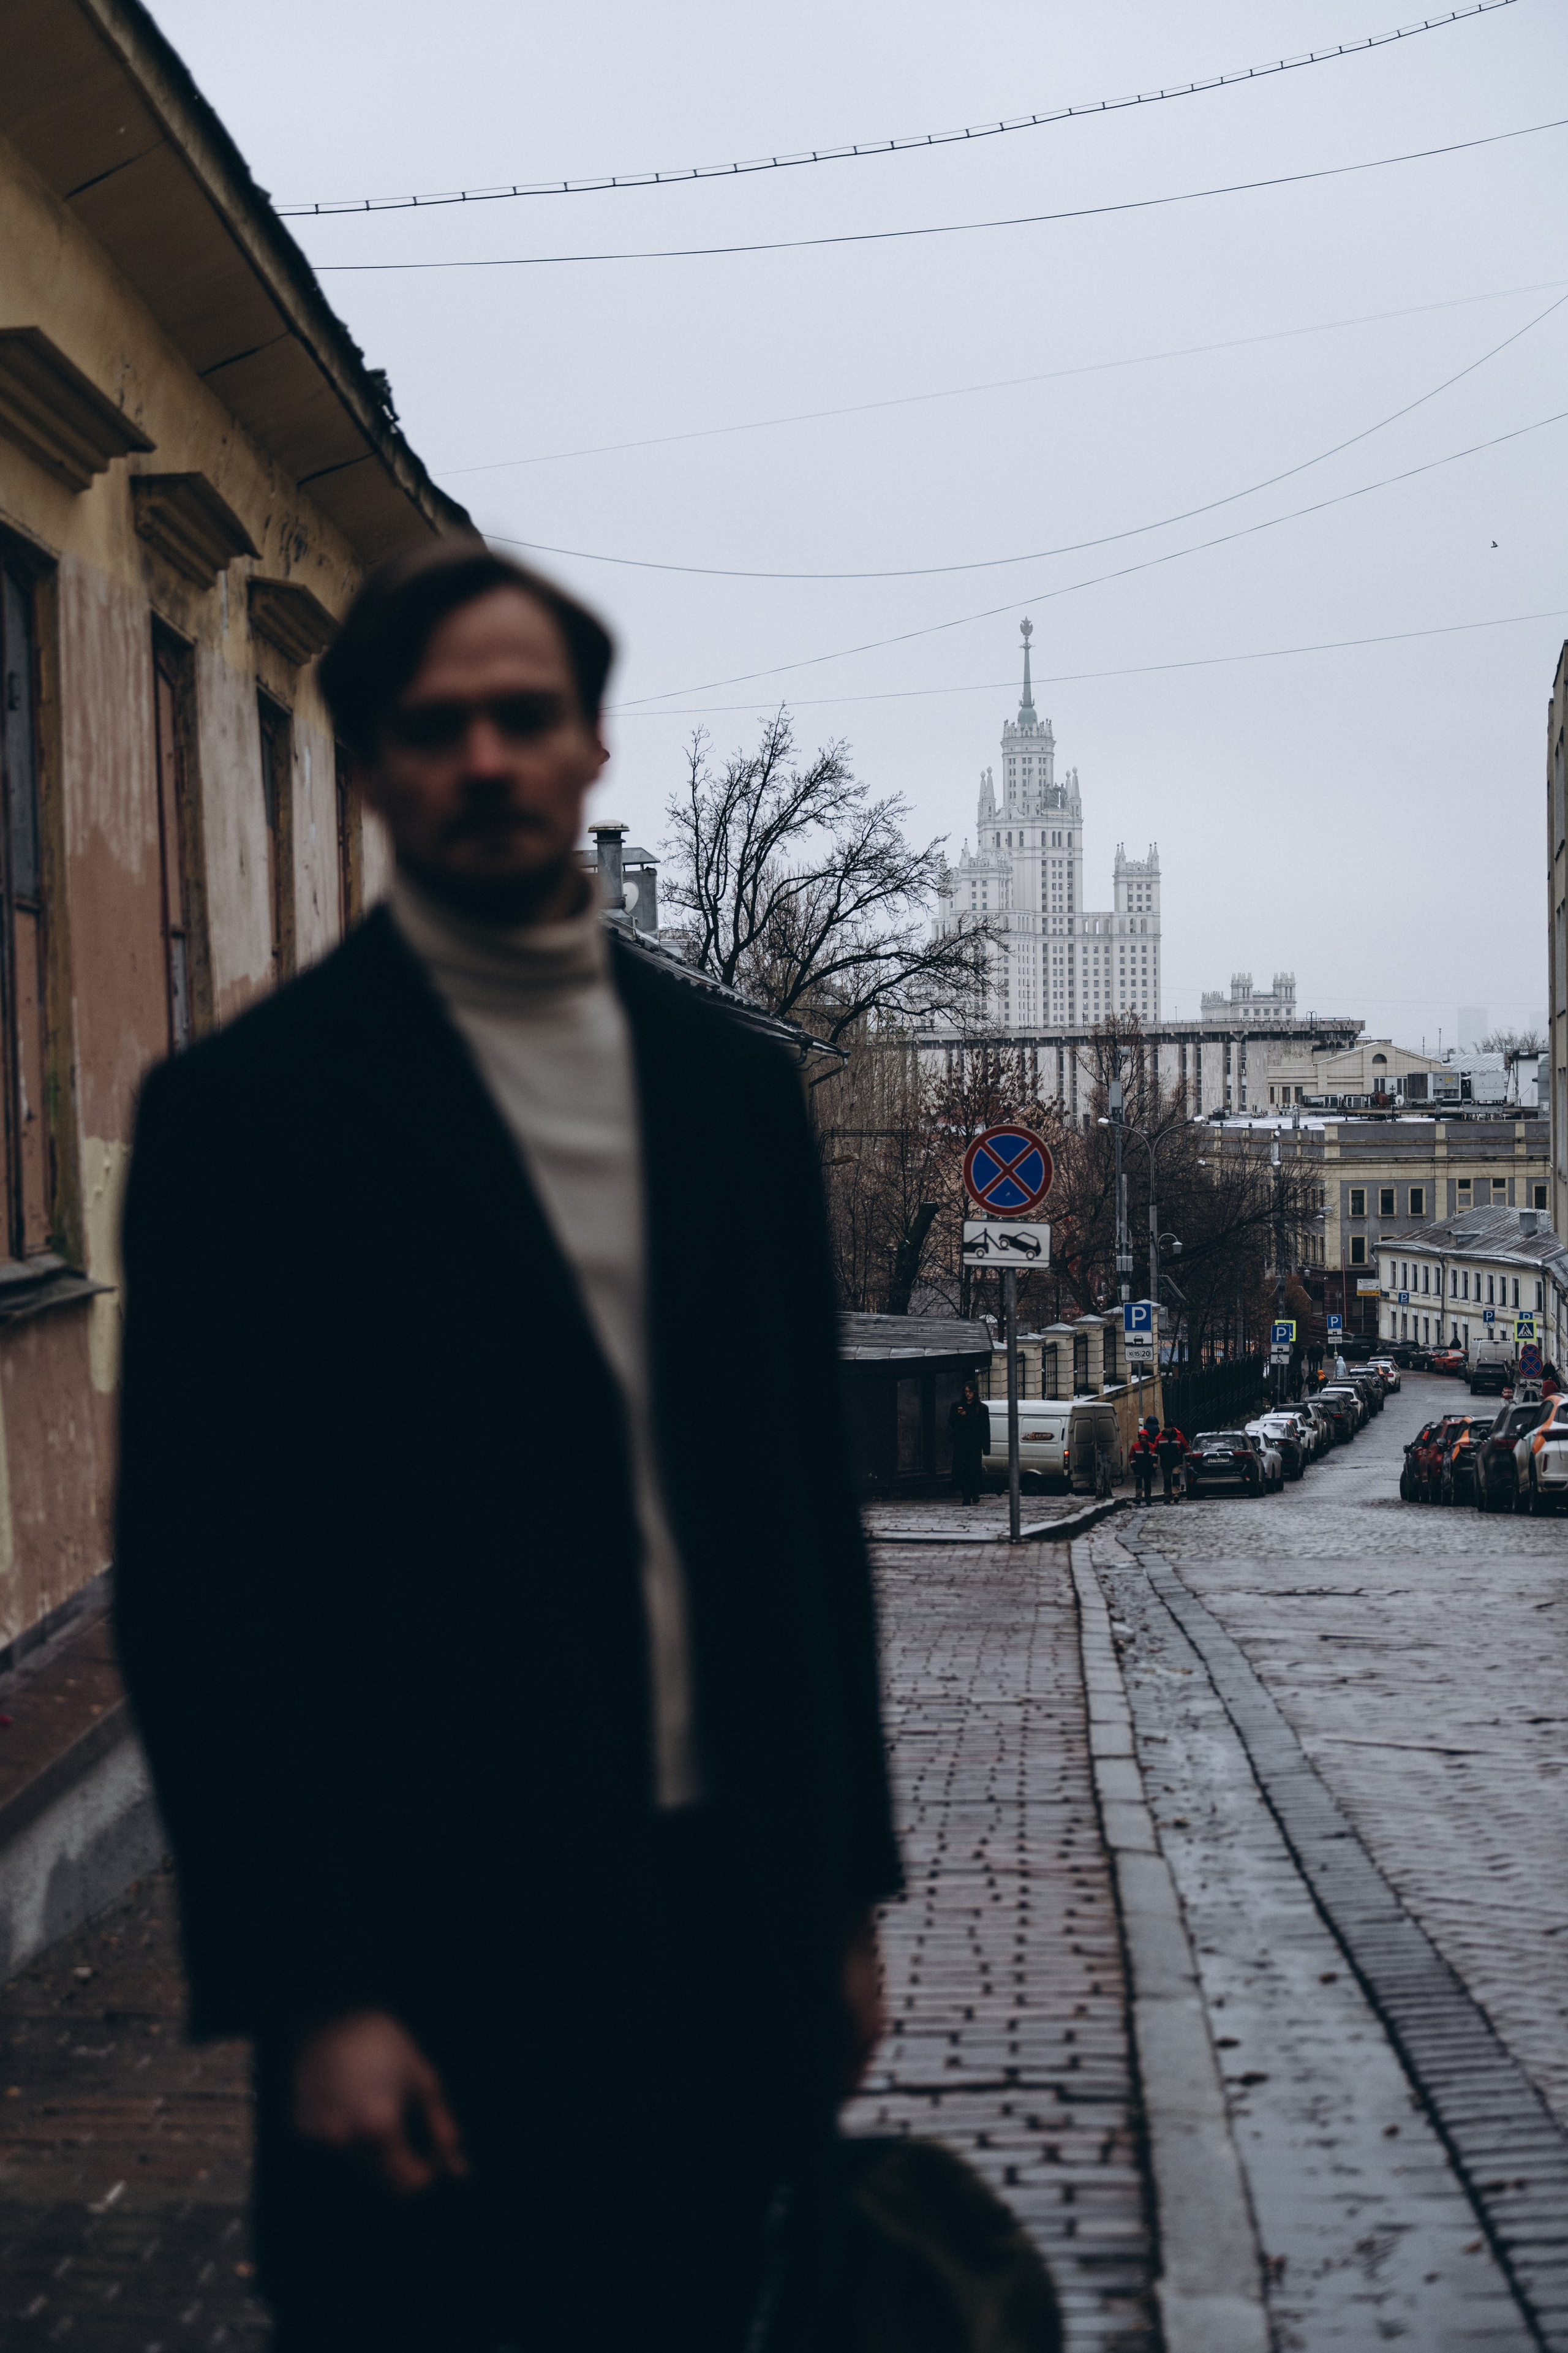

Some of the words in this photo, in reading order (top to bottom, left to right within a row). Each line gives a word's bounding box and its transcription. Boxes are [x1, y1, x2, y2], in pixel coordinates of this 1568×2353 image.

[1401, 1294, 1408, 1302] P
[1132, 1307, 1147, 1328] P
[1331, 1316, 1338, 1327] P
[1486, 1312, 1493, 1321] P
[1276, 1327, 1287, 1342] P
